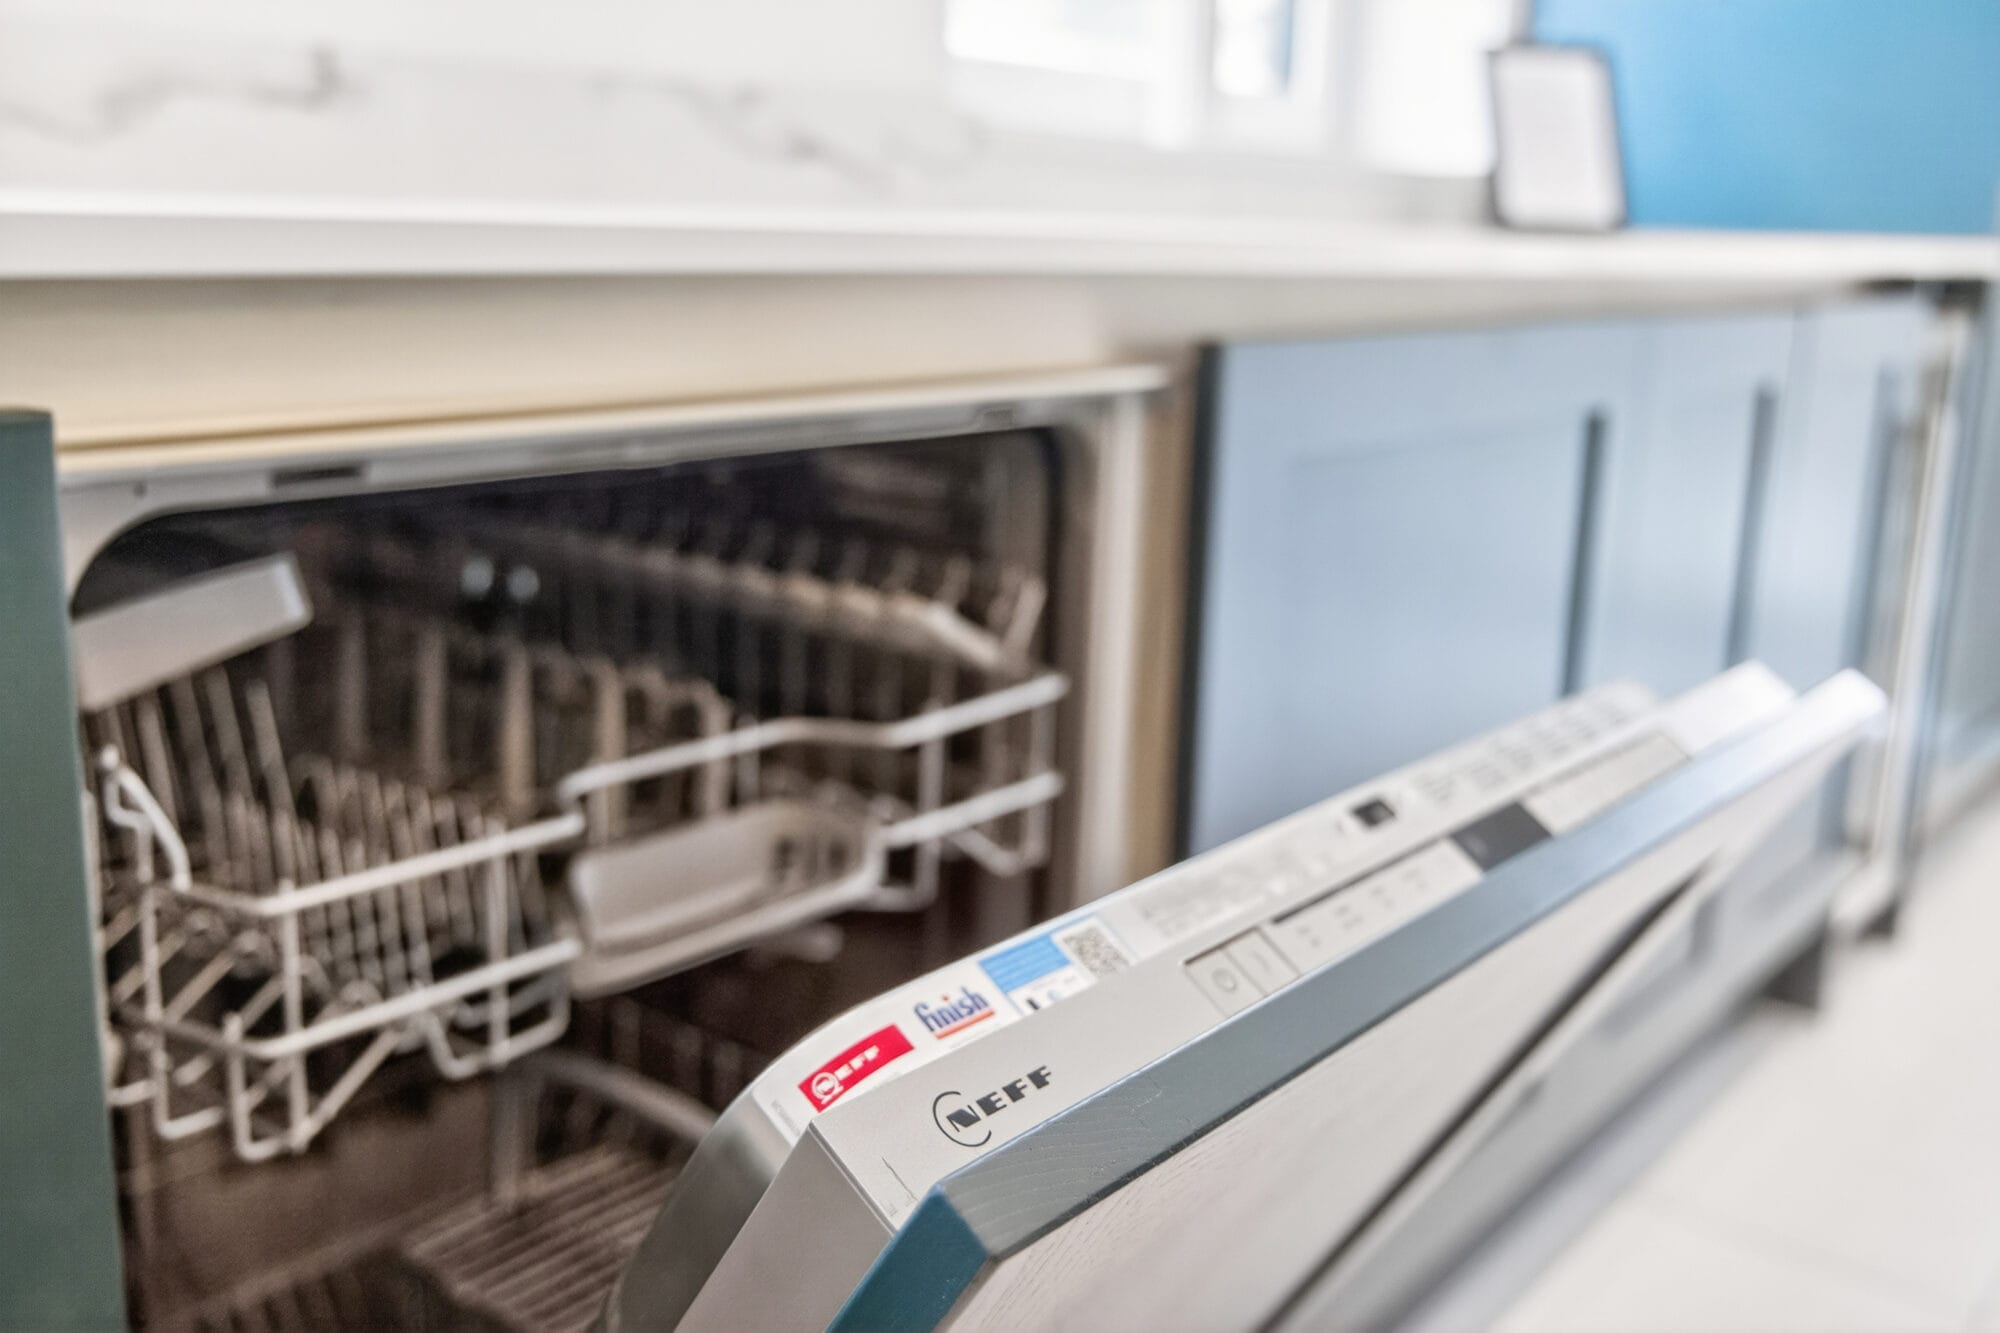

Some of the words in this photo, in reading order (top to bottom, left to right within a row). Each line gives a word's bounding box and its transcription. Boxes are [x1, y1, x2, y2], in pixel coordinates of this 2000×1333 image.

[914, 986, 989, 1033] finish
[811, 1045, 880, 1100] NEFF
[945, 1065, 1052, 1134] NEFF
